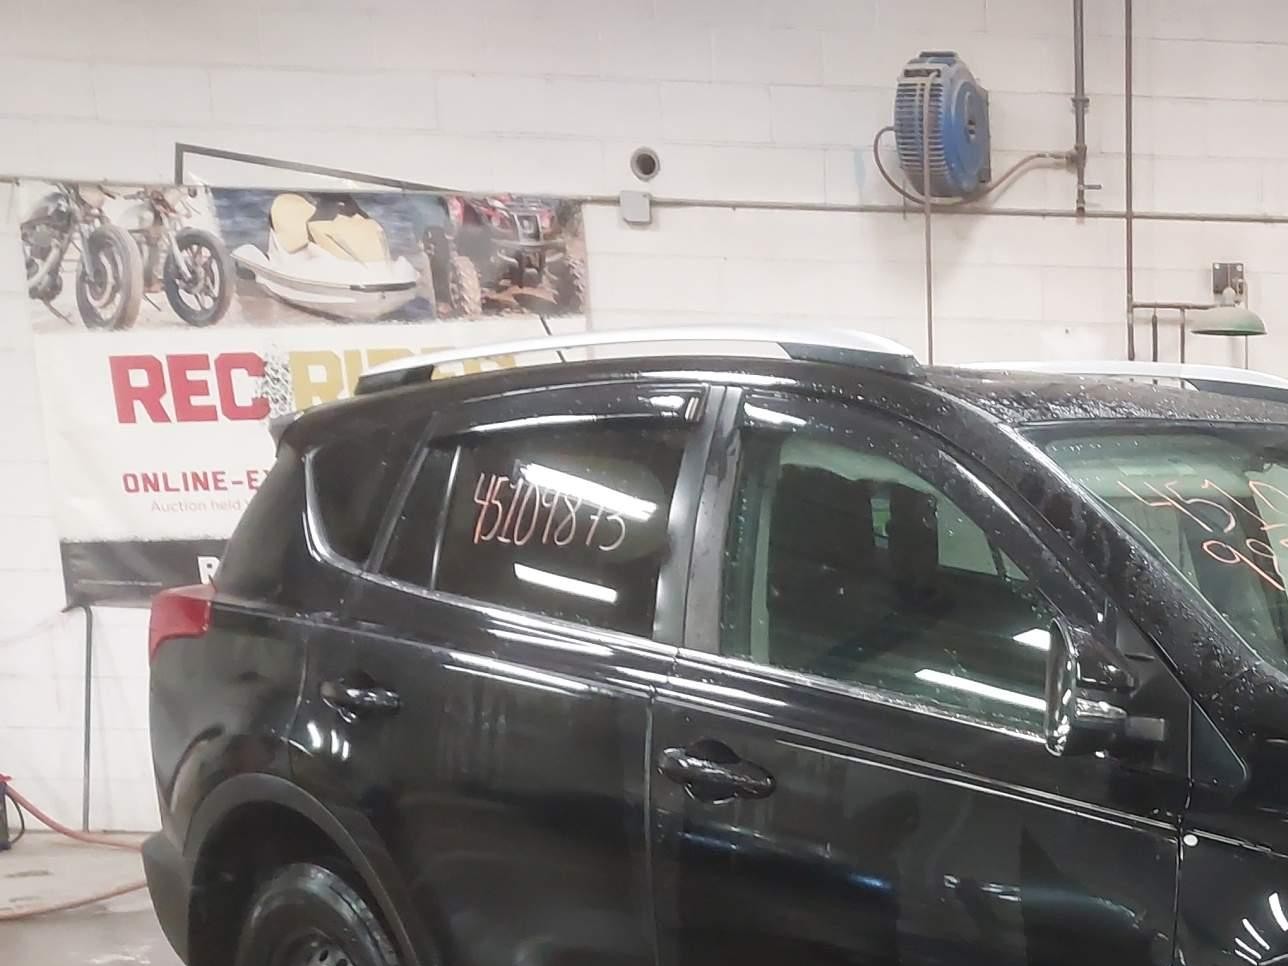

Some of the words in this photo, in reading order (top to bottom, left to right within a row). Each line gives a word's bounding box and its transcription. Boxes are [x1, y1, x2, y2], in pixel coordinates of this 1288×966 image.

[109, 352, 271, 424] REC
[151, 501, 207, 513] Auction
[211, 499, 241, 511] held
